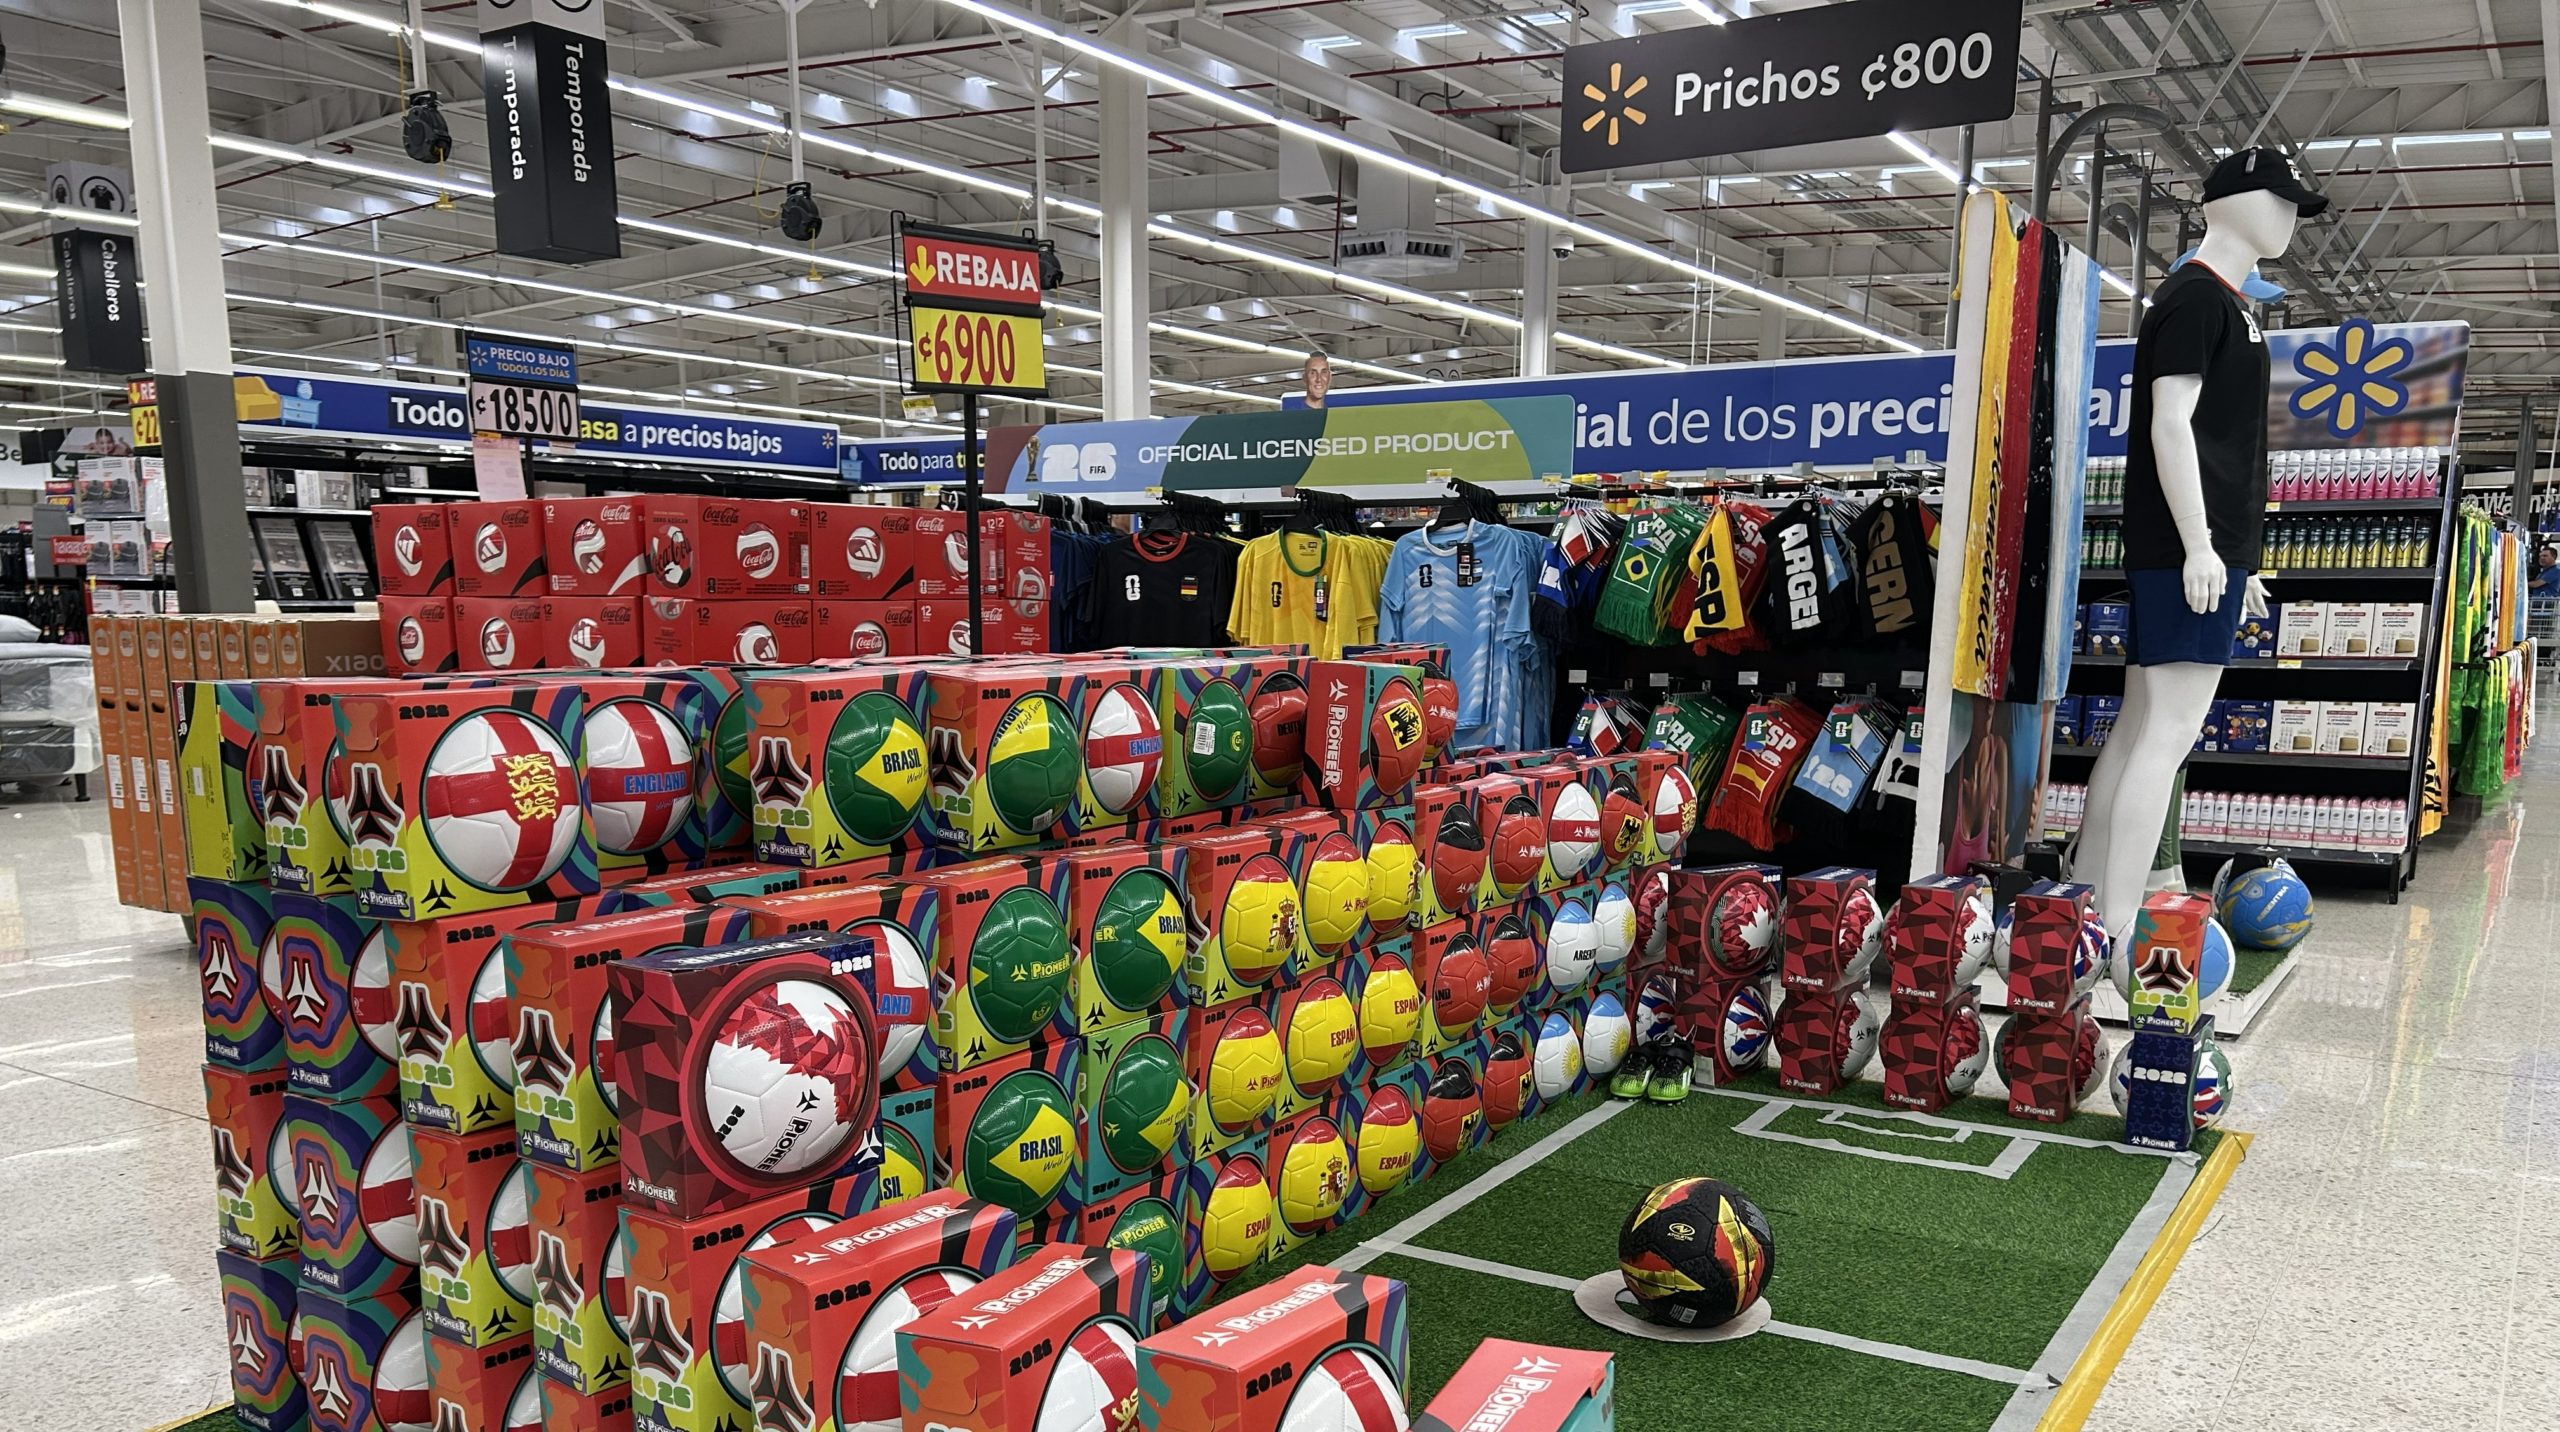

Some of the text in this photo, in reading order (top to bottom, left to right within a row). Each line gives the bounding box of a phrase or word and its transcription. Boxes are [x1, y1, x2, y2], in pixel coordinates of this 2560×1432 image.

[1674, 31, 1993, 117] Prichos ¢800
[502, 35, 526, 182] Temporada
[564, 42, 591, 184] Temporada
[61, 236, 78, 322] Caballeros
[100, 237, 120, 323] Caballeros
[935, 250, 1039, 293] REBAJA
[489, 346, 570, 368] PRECIO BAJO
[918, 313, 1016, 386] ¢6900
[496, 361, 571, 379] TODOS LOS DÍAS
[391, 396, 464, 428] Todo
[624, 423, 638, 442] a
[641, 423, 723, 450] precios
[726, 425, 783, 457] bajos
[1575, 402, 1631, 449] ial
[1647, 398, 1711, 446] de
[1723, 396, 1797, 443] los
[1138, 430, 1515, 465] OFFICIAL LICENSED PRODUCT
[879, 453, 918, 472] Todo
[920, 454, 954, 474] para
[1089, 466, 1107, 475] FIFA
[545, 505, 555, 517] 12
[696, 607, 711, 620] 12
[816, 607, 830, 619] 12
[921, 605, 932, 617] 12
[810, 689, 844, 703] 2026
[981, 688, 1012, 700] 2026
[399, 704, 450, 720] 2026
[1322, 703, 1350, 791] PIONEER
[881, 746, 923, 775] BRASIL
[624, 769, 686, 796] ENGLAND
[754, 806, 810, 827] 2026
[265, 825, 308, 849] 2026
[351, 846, 408, 873] 2026
[770, 843, 808, 857] PIONEER
[1216, 853, 1241, 867] 2026
[1083, 866, 1113, 881] 2026
[763, 879, 798, 896] 2026
[955, 888, 990, 905] 2026
[369, 891, 408, 907] PIONEER
[2256, 885, 2290, 922] ARGENTINA
[446, 925, 496, 944] 2026
[573, 949, 622, 970] 2026
[830, 954, 873, 976] 2026
[1031, 952, 1070, 980] PIONEER
[1795, 976, 1825, 988] PIONEER
[1905, 987, 1937, 999] PIONEER
[2023, 998, 2056, 1010] PIONEER
[2133, 990, 2190, 1009] 2026
[2146, 1015, 2183, 1029] PIONEER
[213, 1042, 241, 1060] PIONEER
[299, 1069, 332, 1088] PIONEER
[400, 1060, 453, 1087] 2026
[953, 1075, 988, 1094] 2026
[1793, 1078, 1822, 1091] PIONEER
[2132, 1066, 2188, 1085] 2026
[417, 1102, 452, 1120] PIONEER
[515, 1088, 574, 1122] 2026
[894, 1098, 933, 1118] 2026
[1898, 1094, 1928, 1107] PIONEER
[2024, 1105, 2057, 1118] PIONEER
[467, 1140, 516, 1164] 2026
[533, 1134, 573, 1156] PIONEER
[755, 1115, 813, 1173] PIONEE
[1019, 1135, 1064, 1162] BRASIL
[2140, 1136, 2177, 1151] PIONEER
[1378, 1151, 1413, 1171] ESPAÑA
[638, 1179, 679, 1206] PIONEER
[1087, 1205, 1117, 1223] 2026
[227, 1229, 254, 1248] PIONEER
[691, 1223, 746, 1251] 2026
[825, 1204, 962, 1254] PIONEER
[1121, 1214, 1170, 1245] PIONEER
[311, 1265, 341, 1288] PIONEER
[421, 1271, 471, 1302] 2026
[977, 1257, 1094, 1317] PIONEER
[814, 1280, 872, 1310] 2026
[1222, 1280, 1348, 1335] PIONEER
[434, 1312, 468, 1335] PIONEER
[534, 1304, 583, 1347] 2026
[484, 1343, 532, 1369] 2026
[547, 1353, 581, 1379] PIONEER
[1009, 1338, 1053, 1378] 2026
[631, 1368, 693, 1412] 2026
[1245, 1363, 1293, 1401] 2026
[244, 1409, 272, 1431] PIONEER
